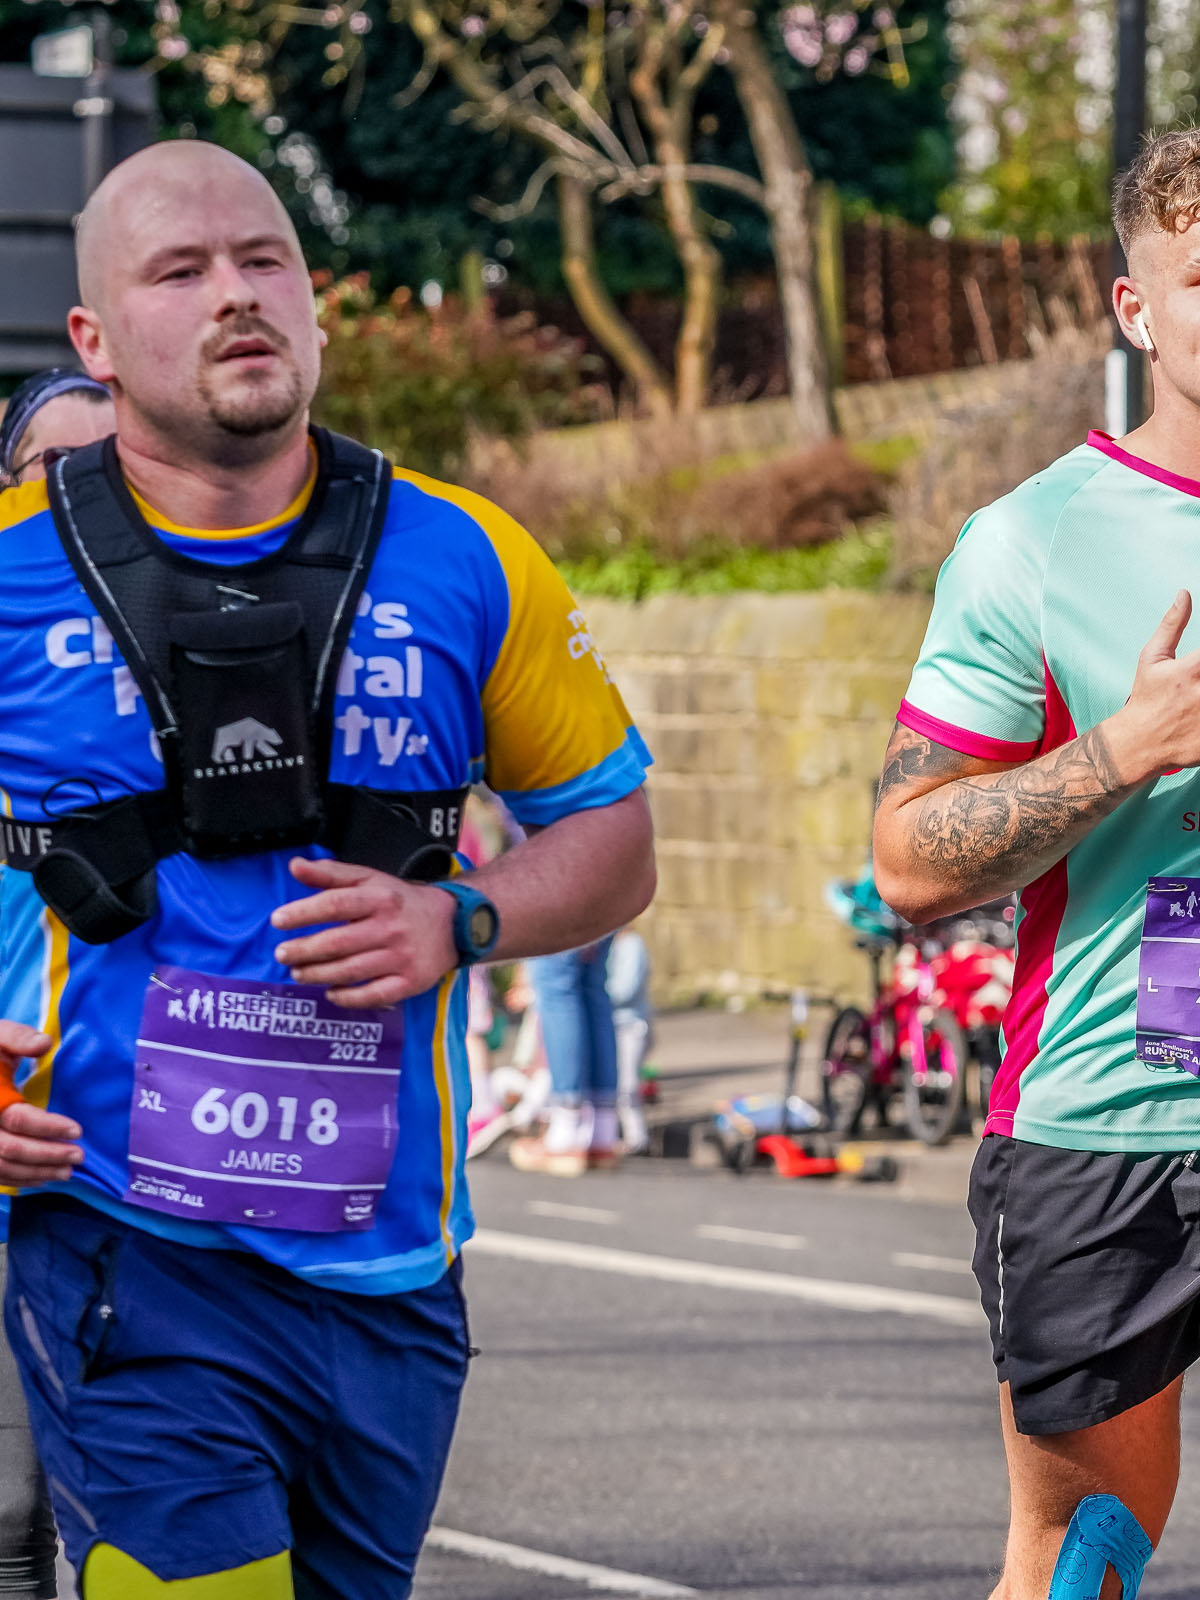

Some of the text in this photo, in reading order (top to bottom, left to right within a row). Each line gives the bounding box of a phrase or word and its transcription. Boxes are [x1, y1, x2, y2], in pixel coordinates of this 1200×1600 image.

[194, 755, 304, 779] BEARACTIVE
[1147, 977, 1159, 993] L
[221, 991, 314, 1017] SHEFFIELD
[218, 1011, 381, 1042] HALF MARATHON
[329, 1042, 378, 1062] 2022
[1144, 1046, 1168, 1056] RUN
[1169, 1050, 1190, 1061] FOR
[137, 1088, 167, 1113] XL
[190, 1087, 340, 1146] 6018
[220, 1149, 304, 1175] JAMES
